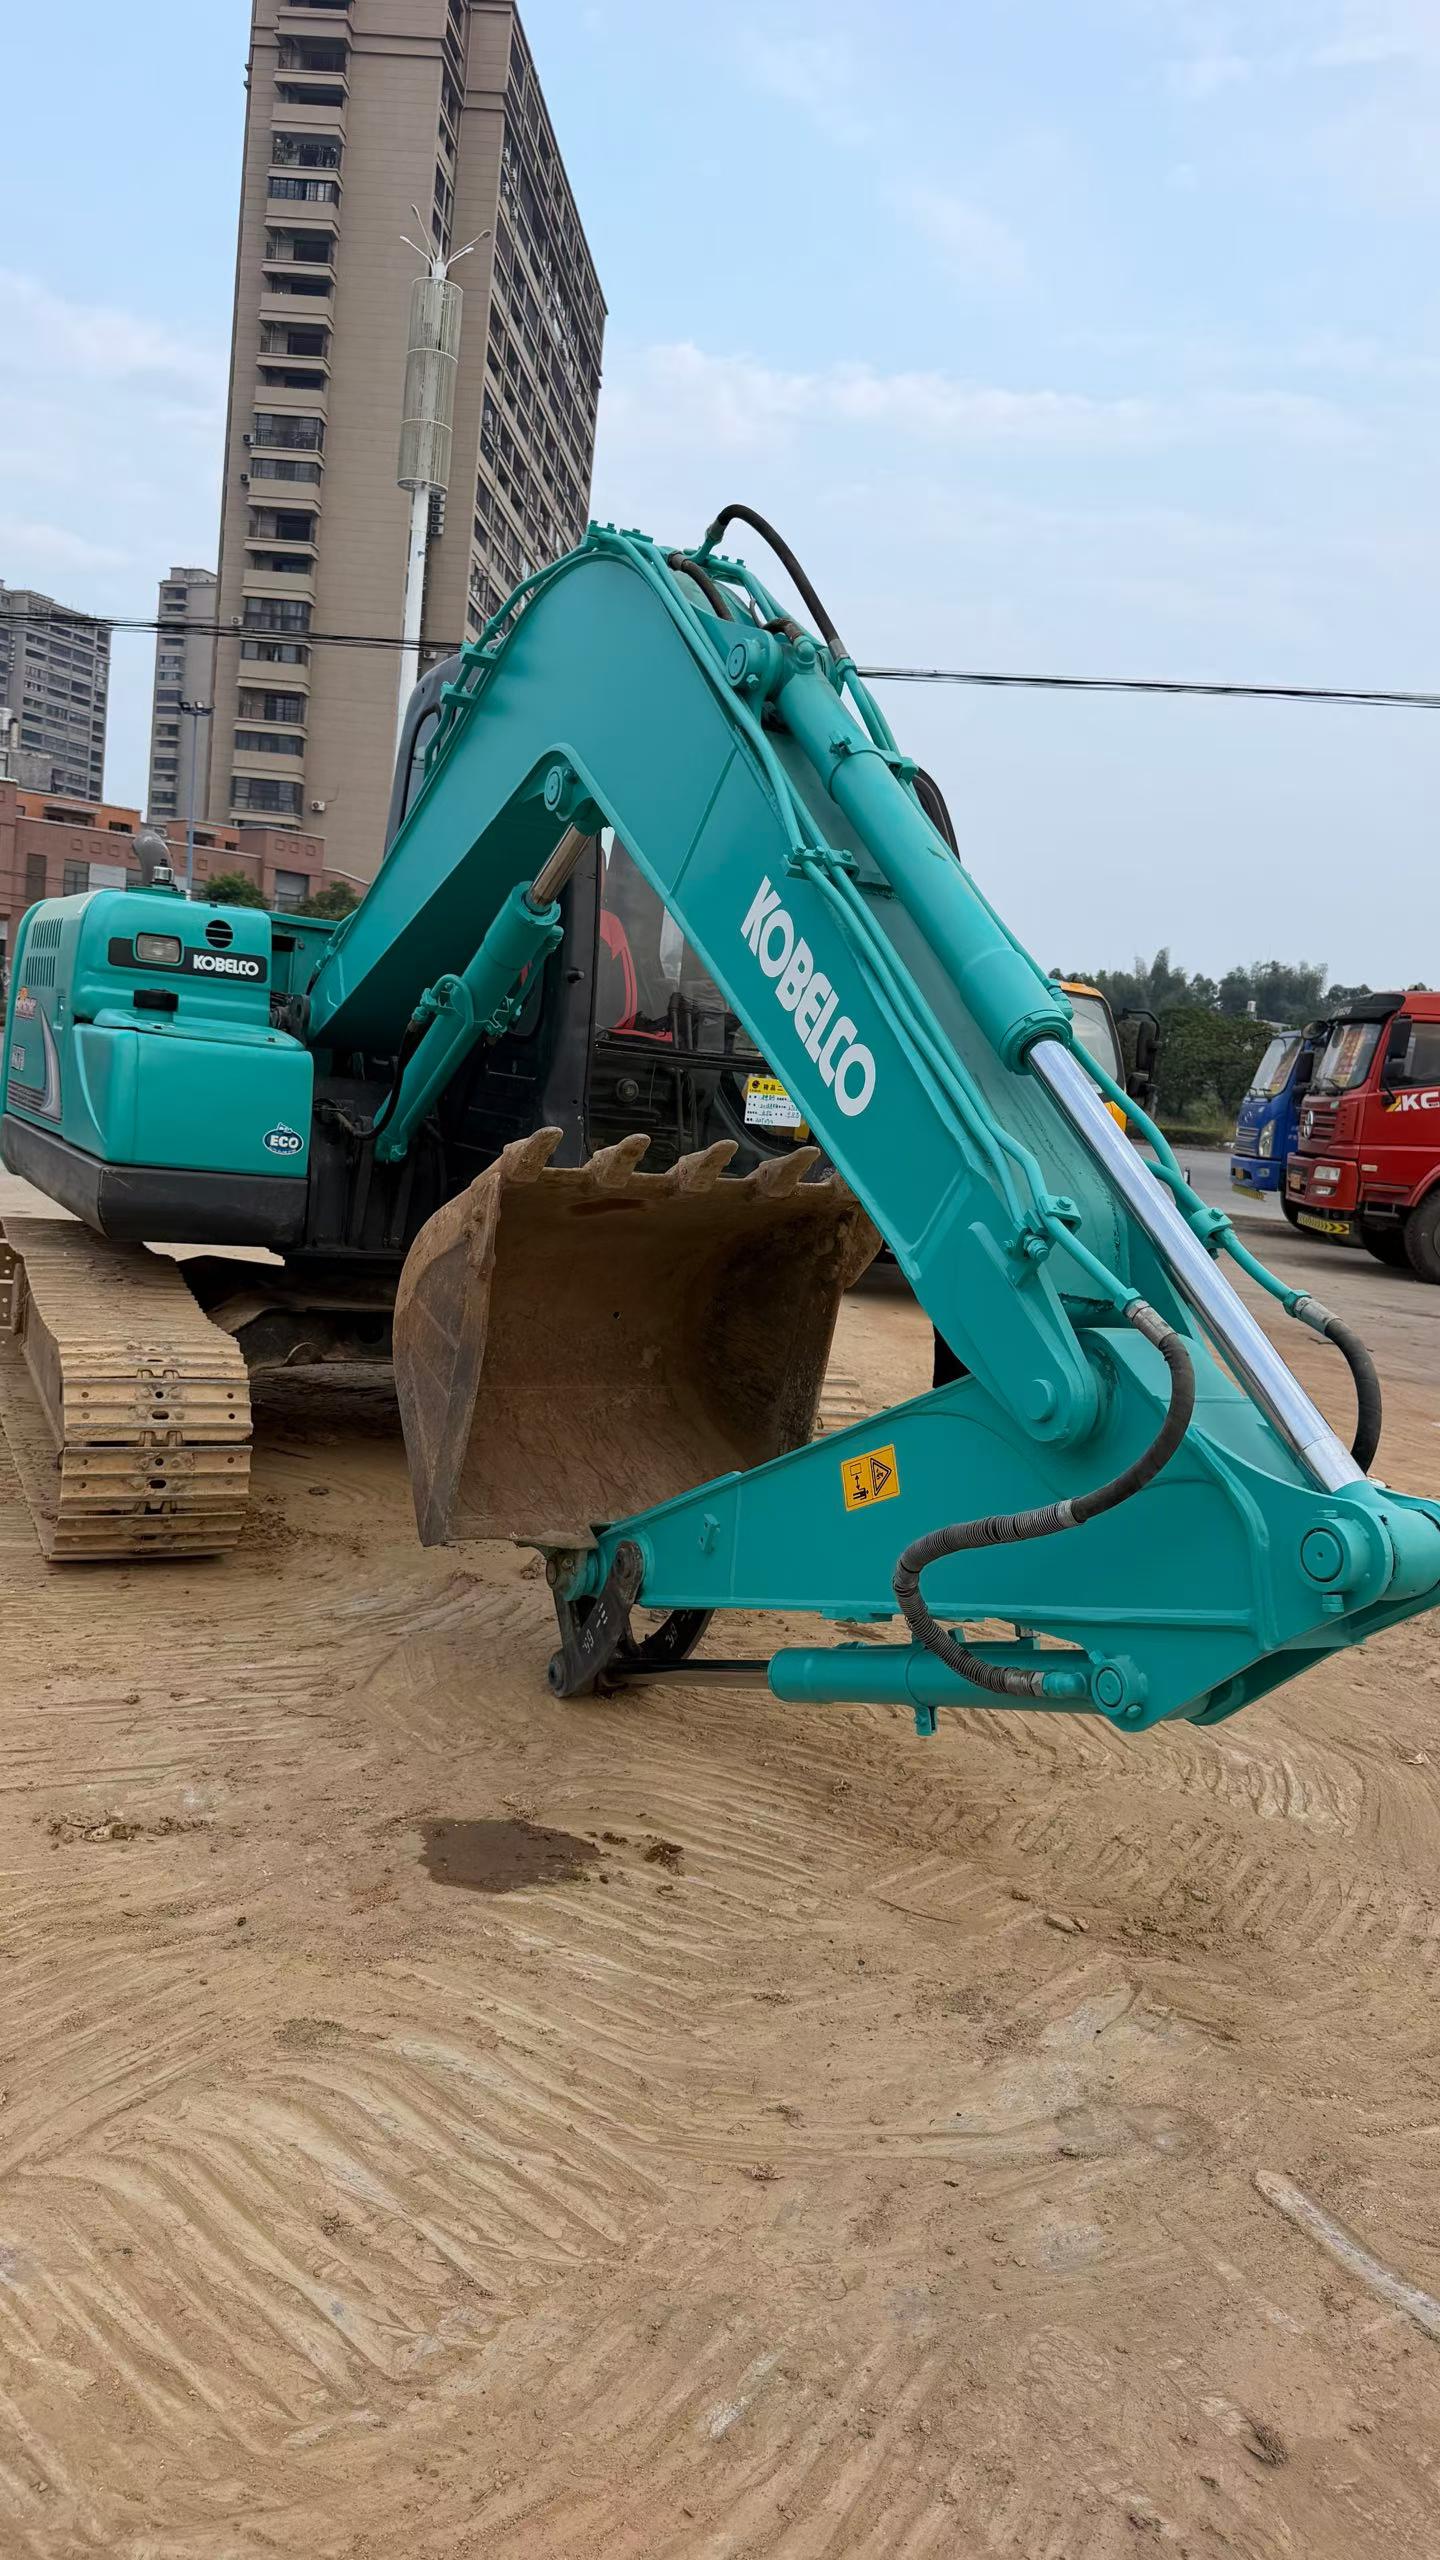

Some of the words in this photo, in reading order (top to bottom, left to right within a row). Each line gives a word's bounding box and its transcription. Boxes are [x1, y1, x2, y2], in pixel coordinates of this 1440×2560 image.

[193, 954, 259, 976] KOBELCO
[741, 875, 876, 1117] KOBELCO
[270, 1134, 299, 1149] ECO
